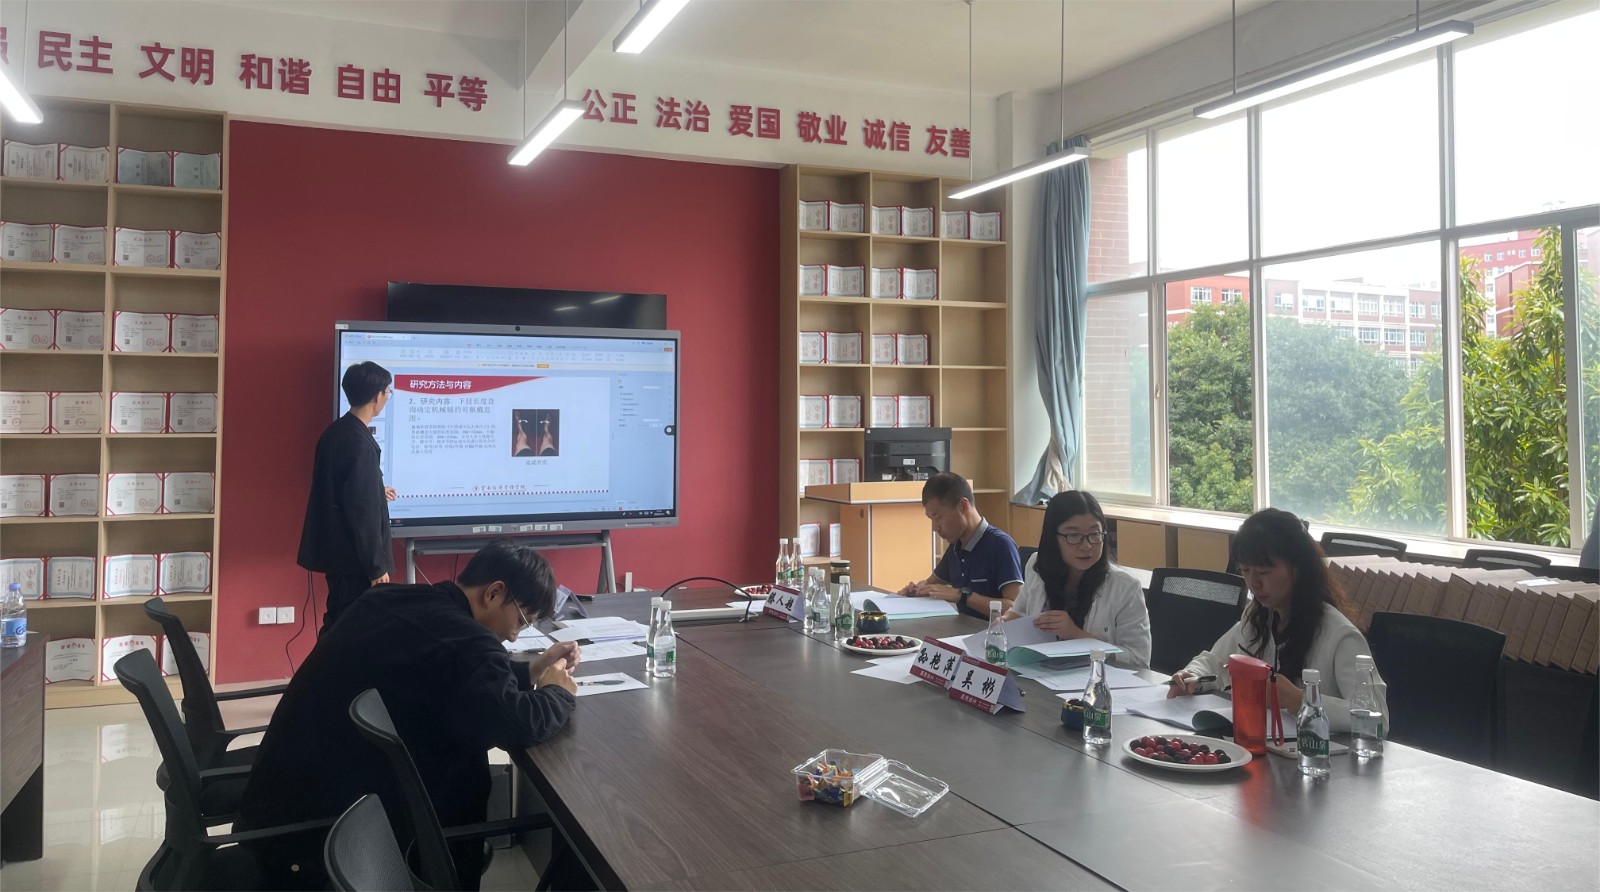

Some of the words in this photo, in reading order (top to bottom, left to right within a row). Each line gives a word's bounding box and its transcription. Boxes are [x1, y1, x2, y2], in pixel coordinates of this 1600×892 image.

[37, 30, 113, 75] 民主
[139, 42, 214, 86] 文明
[238, 53, 313, 96] 和谐
[337, 64, 401, 104] 自由
[423, 73, 488, 112] 平等
[581, 89, 638, 125] 公正
[655, 97, 711, 133] 法治
[728, 104, 781, 140] 爱国
[797, 111, 848, 146] 敬业
[862, 119, 912, 152] 诚信
[925, 125, 972, 158] 友善
[409, 380, 471, 390] 研究方法与内容
